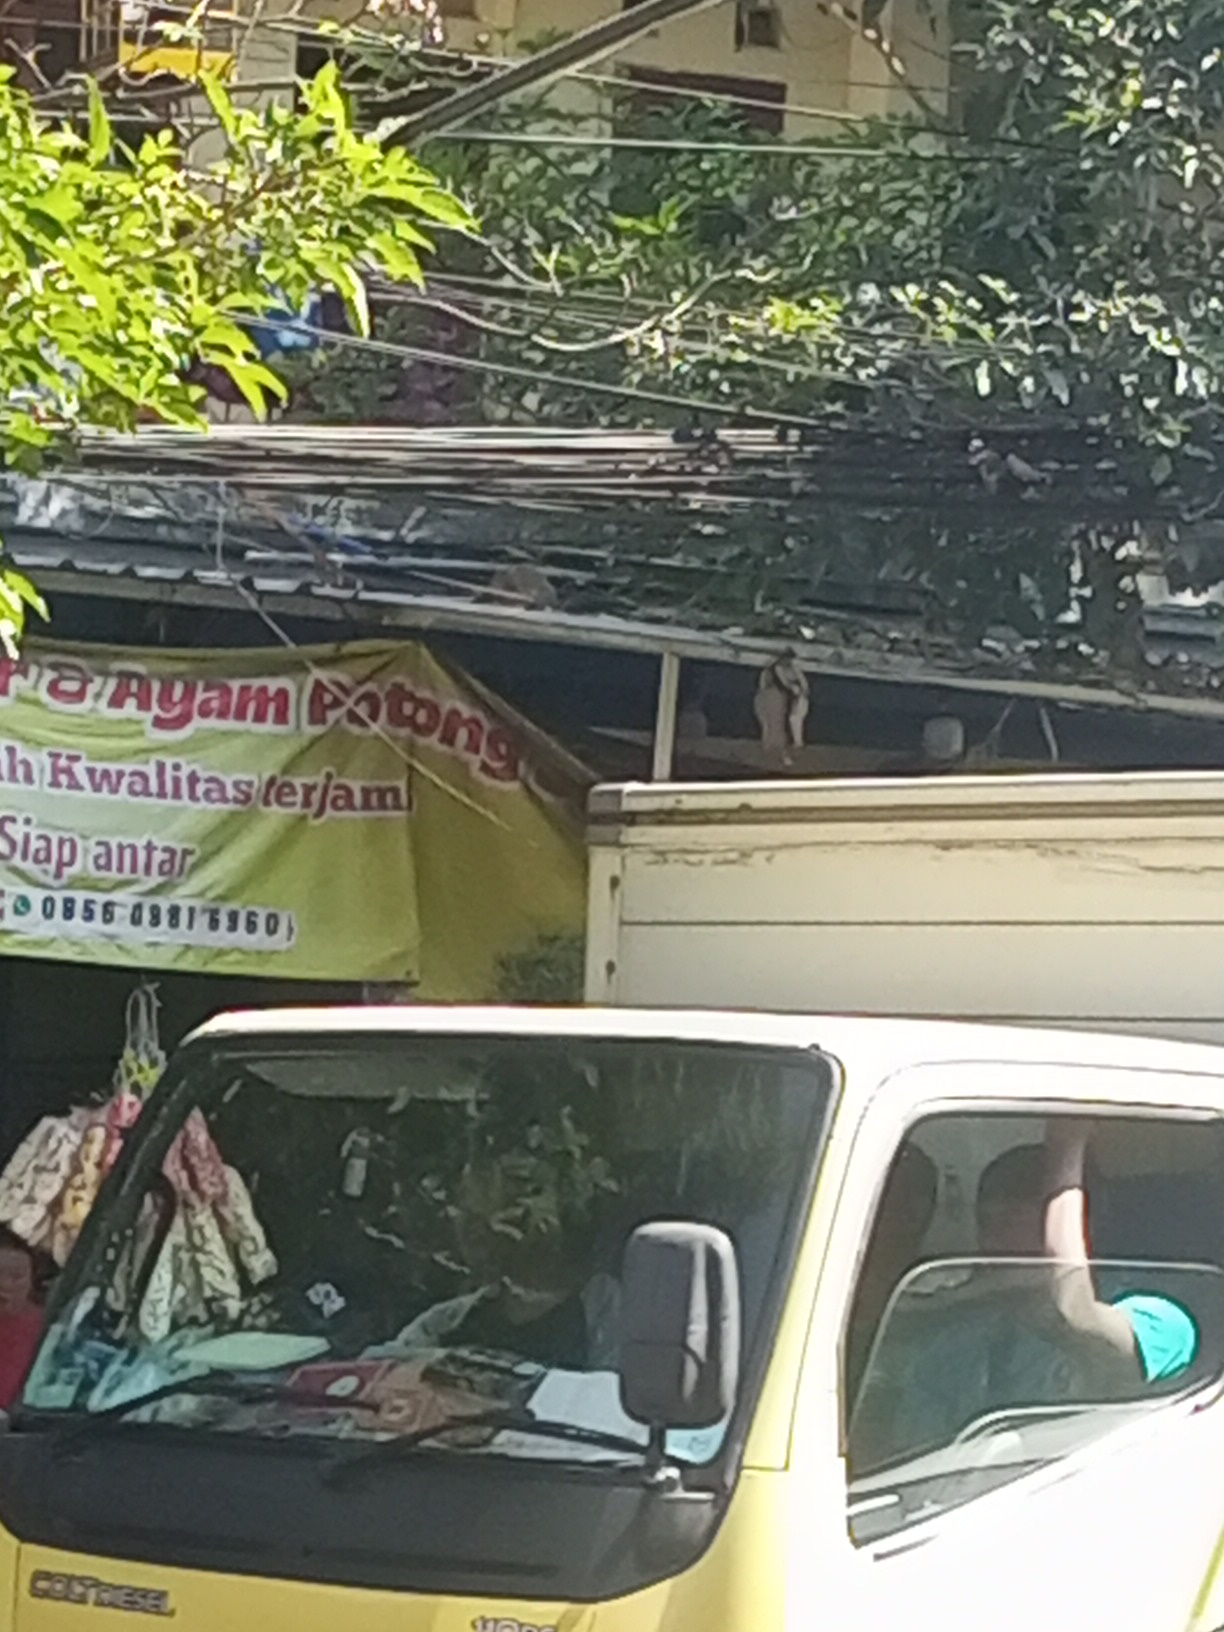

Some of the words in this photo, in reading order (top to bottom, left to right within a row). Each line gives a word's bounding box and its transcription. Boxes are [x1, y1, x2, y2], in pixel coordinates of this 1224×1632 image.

[107, 671, 291, 731] Ayam
[307, 678, 520, 784] Potong
[47, 752, 255, 807] Kwalitas
[92, 838, 195, 879] antar
